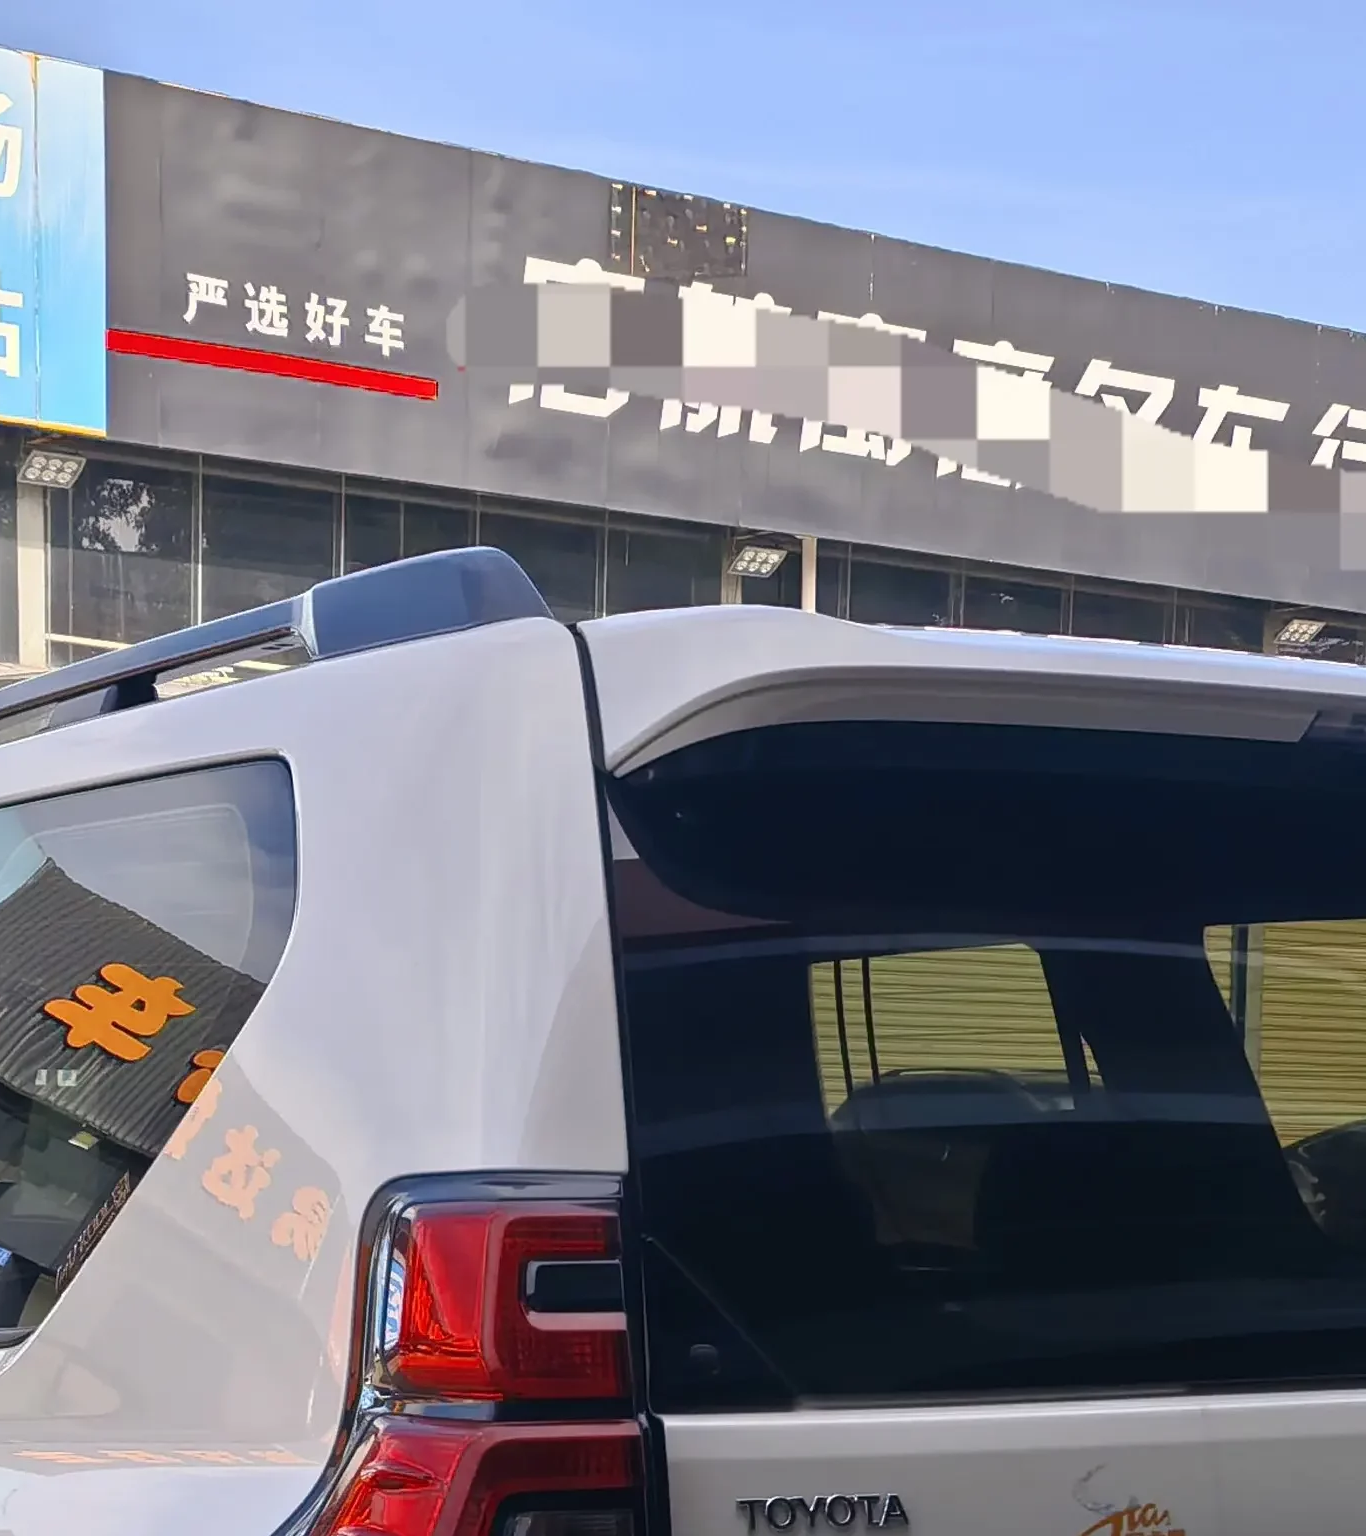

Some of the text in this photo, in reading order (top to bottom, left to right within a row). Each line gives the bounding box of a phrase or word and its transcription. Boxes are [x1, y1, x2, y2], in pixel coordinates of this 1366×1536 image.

[183, 272, 406, 357] 严选好车
[735, 1492, 910, 1532] TOYOTA
